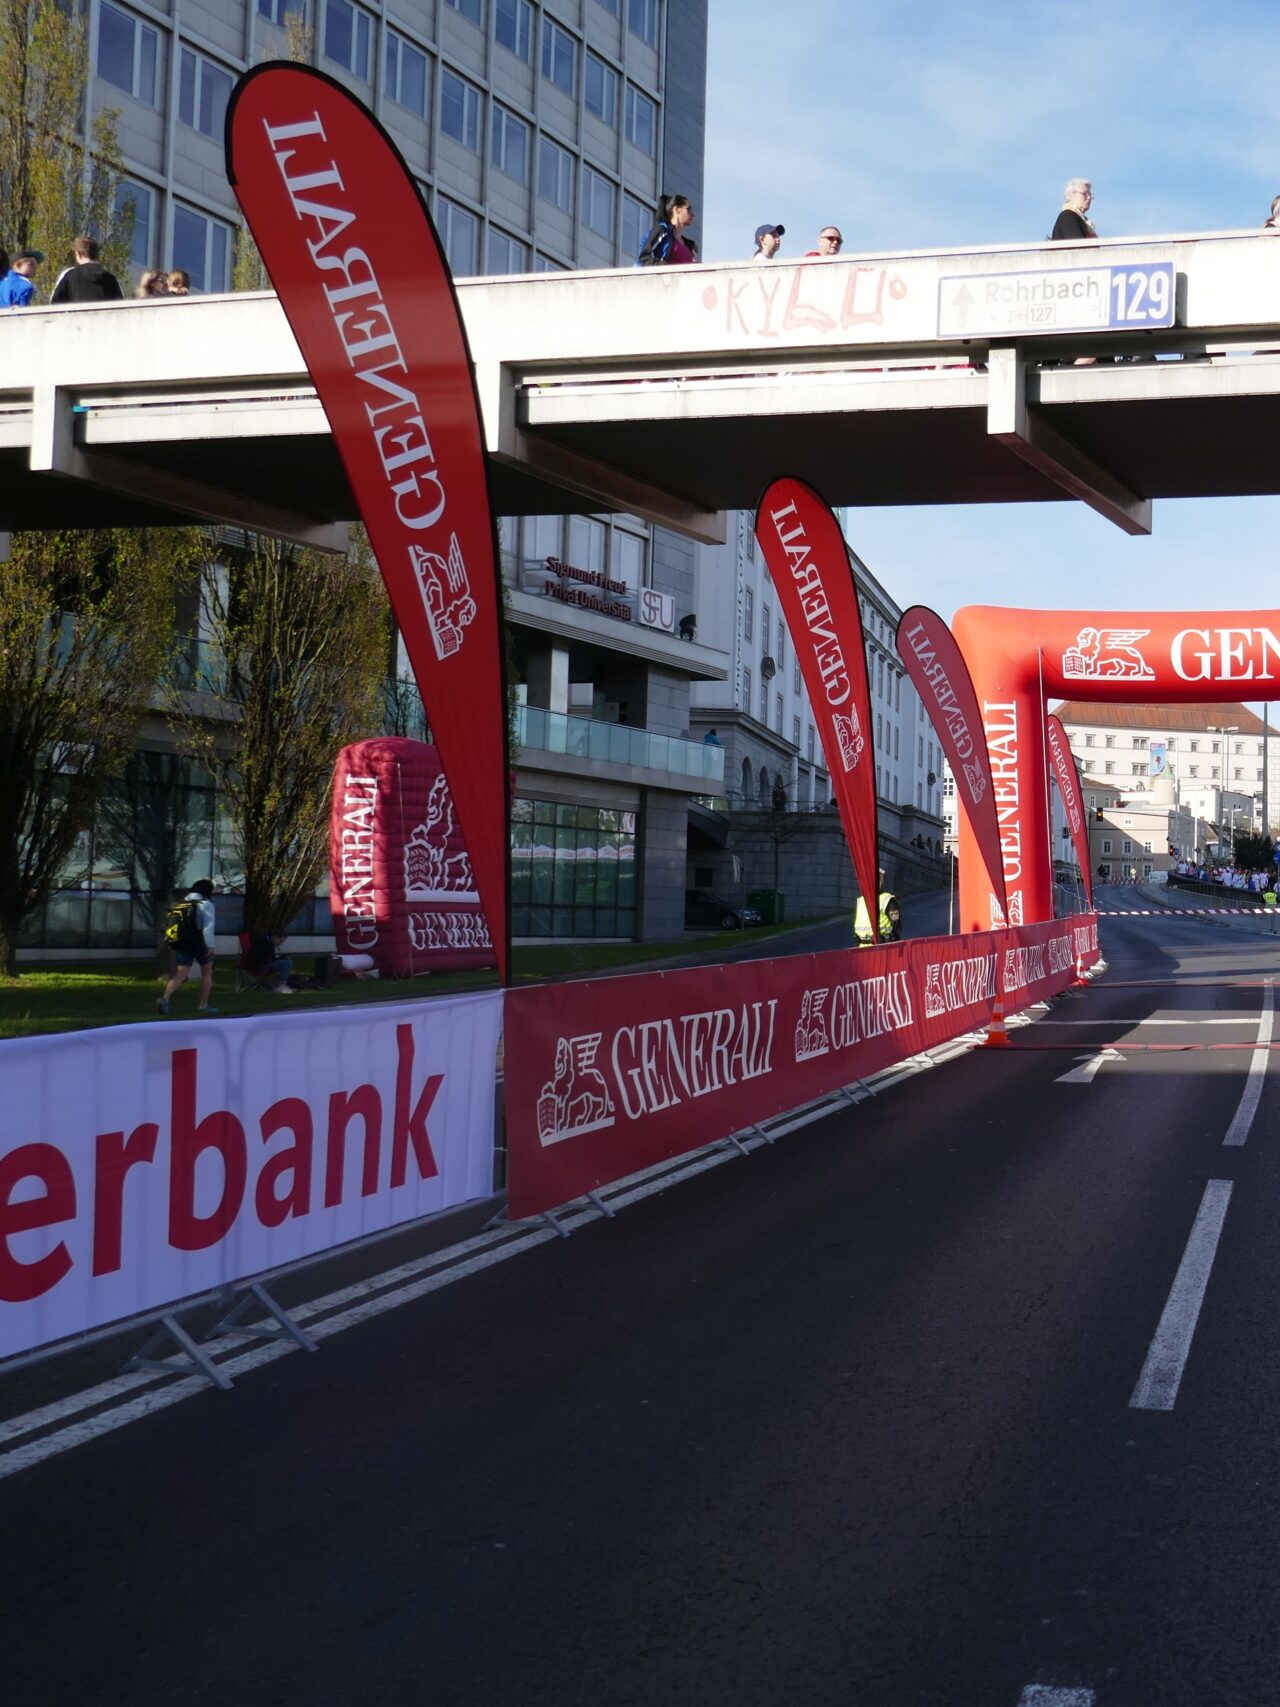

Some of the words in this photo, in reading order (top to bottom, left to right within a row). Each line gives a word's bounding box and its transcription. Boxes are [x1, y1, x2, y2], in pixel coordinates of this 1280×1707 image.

[986, 275, 1099, 303] Rohrbach
[1112, 271, 1170, 320] 129
[1029, 307, 1053, 322] 127
[642, 590, 675, 629] SFU
[984, 700, 1022, 881] GENERALI
[342, 773, 379, 950] GENERALI
[408, 912, 493, 951] GENERAL
[831, 970, 913, 1050] GENERALI
[942, 953, 998, 1012] GENERALI
[610, 1000, 778, 1120] GENERALI
[0, 1024, 445, 1302] erbank
